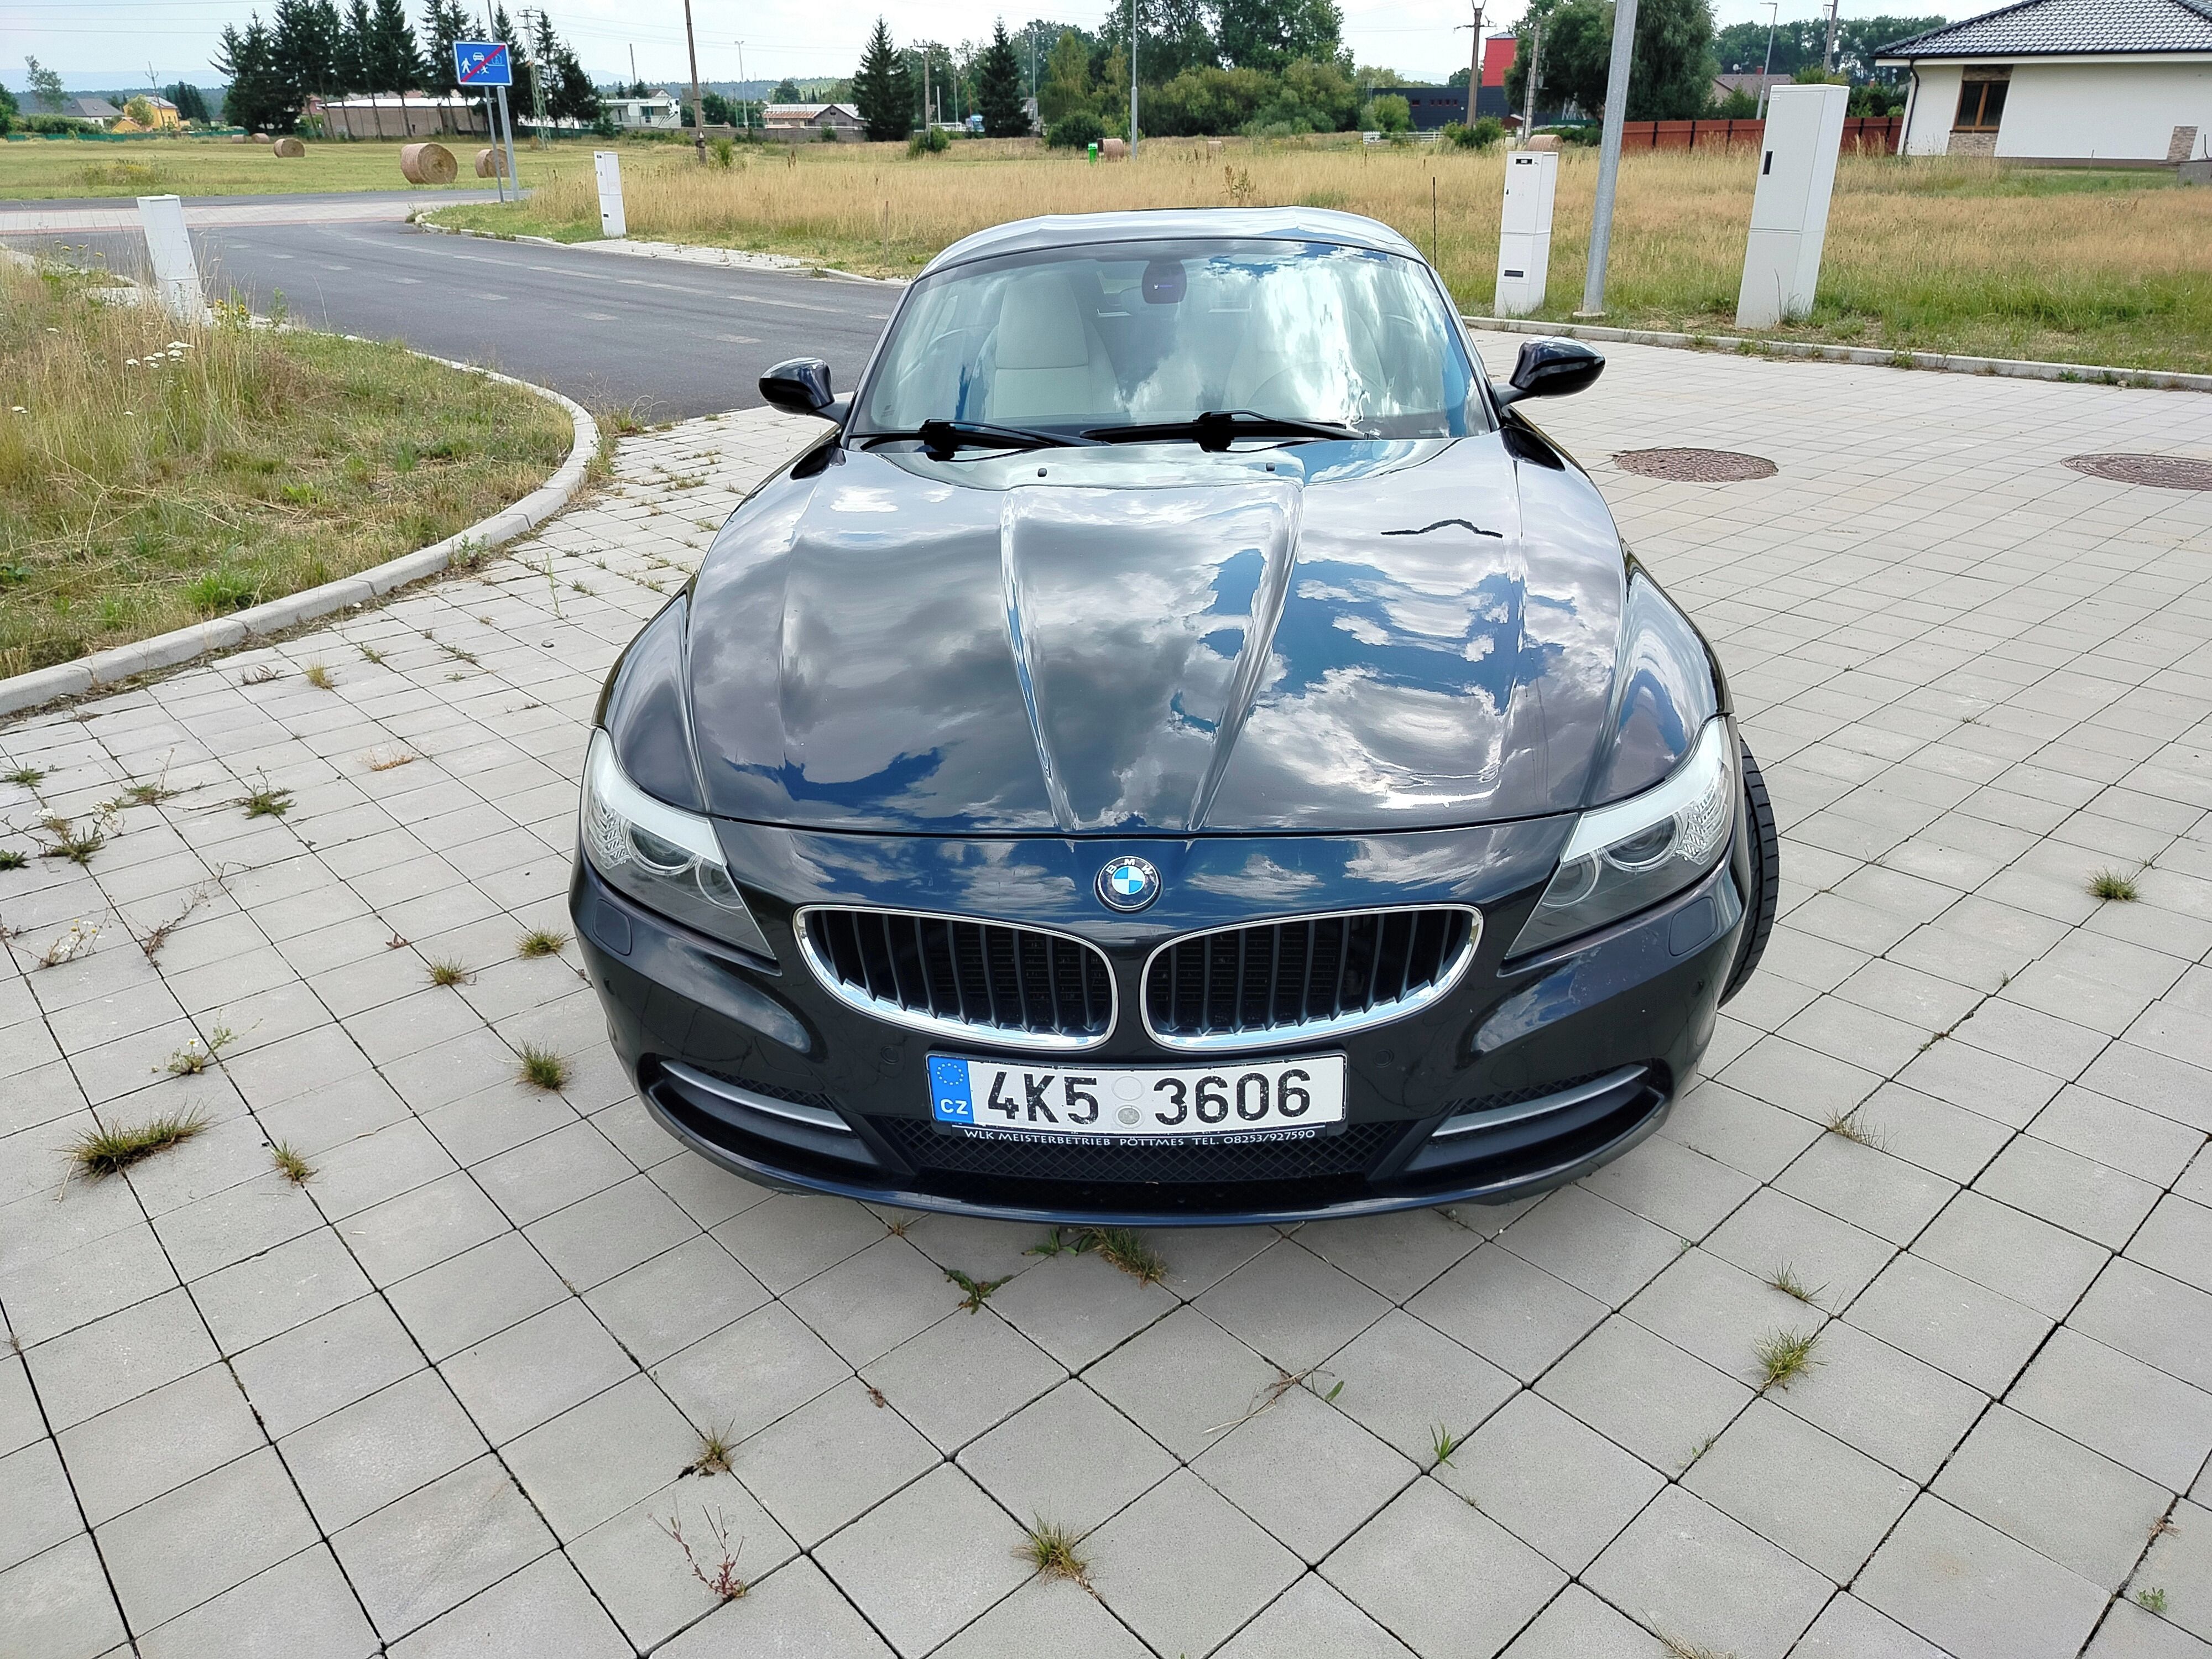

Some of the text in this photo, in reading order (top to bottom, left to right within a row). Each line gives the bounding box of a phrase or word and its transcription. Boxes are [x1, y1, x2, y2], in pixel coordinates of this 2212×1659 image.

[1105, 858, 1153, 874] BMW
[988, 1069, 1311, 1125] 4K5 3606
[941, 1099, 968, 1115] CZ
[964, 1129, 1316, 1146] WLK MEISTERBETRIEB PÖTTMES TEL. 08253/927590
